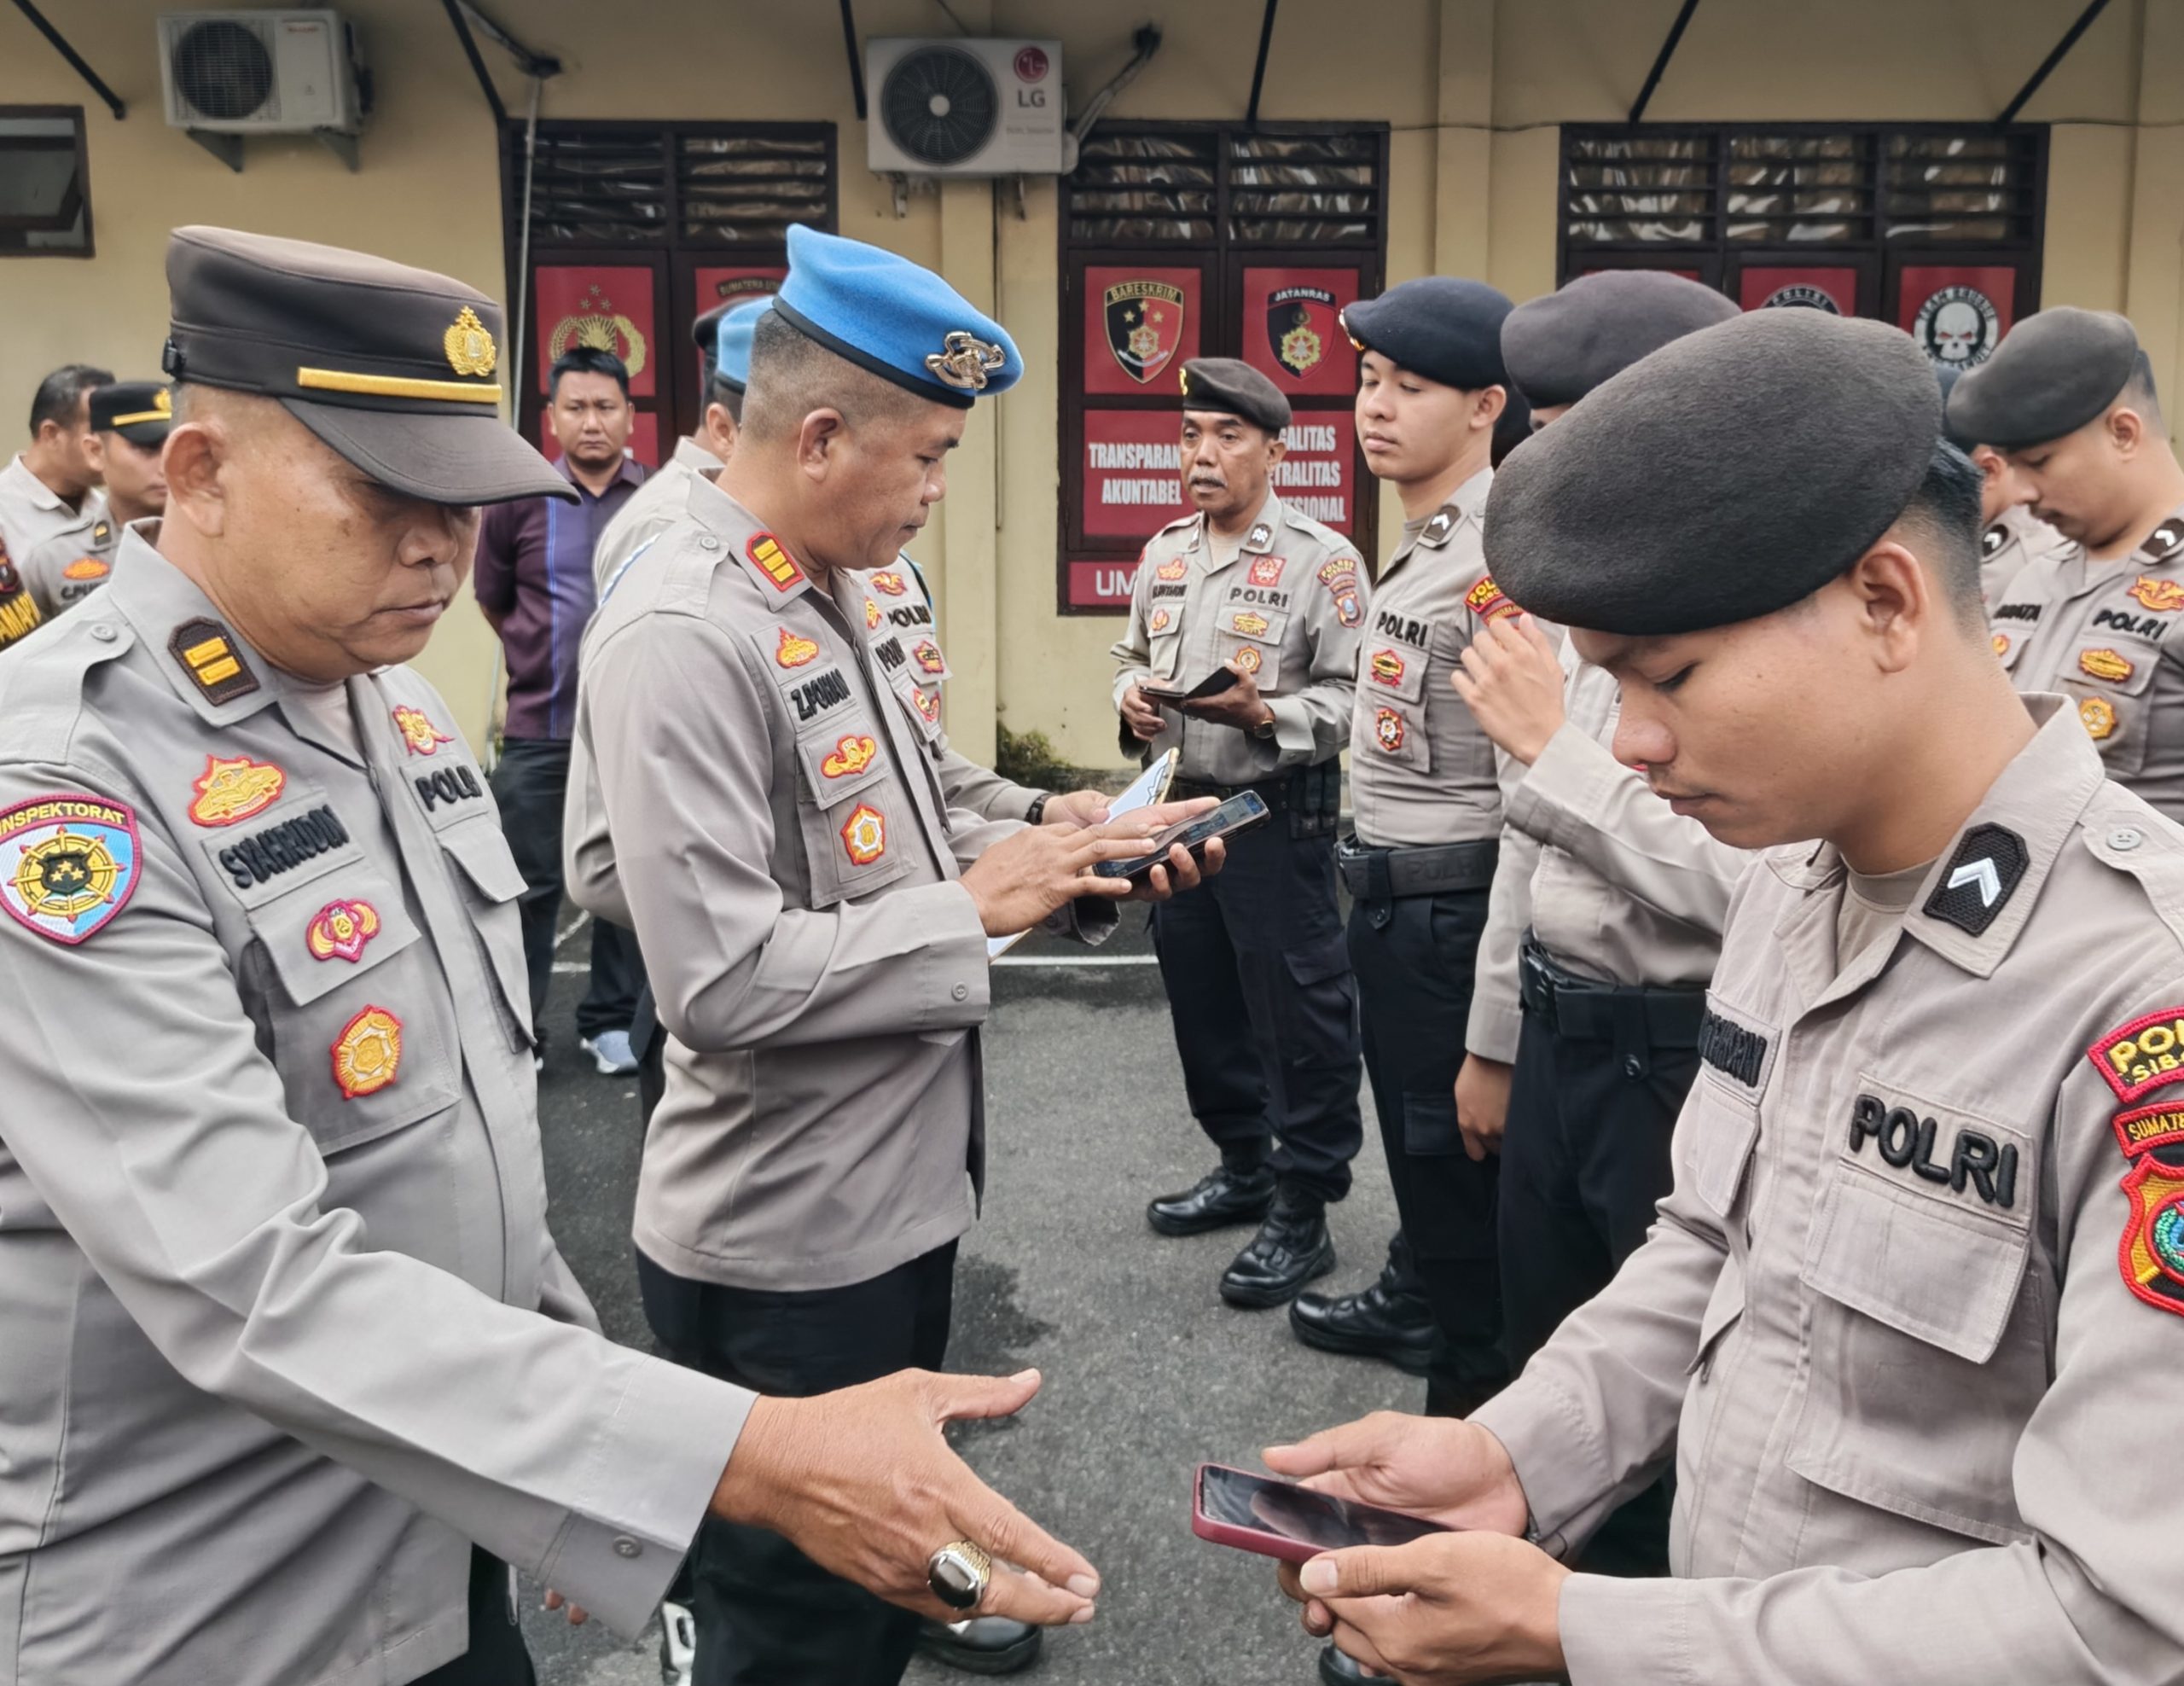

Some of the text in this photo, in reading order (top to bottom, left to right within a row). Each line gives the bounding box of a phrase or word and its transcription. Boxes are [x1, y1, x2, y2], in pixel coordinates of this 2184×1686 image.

[1018, 90, 1045, 108] LG
[1110, 284, 1177, 300] BARESKRIM
[1275, 288, 1330, 301] JATANRAS
[1101, 479, 1182, 505] AKUNTABEL
[1230, 587, 1288, 608] POLRI
[1376, 611, 1428, 648] POLRI
[2093, 609, 2168, 640] POLRI
[1850, 1094, 2018, 1209] POLRI
